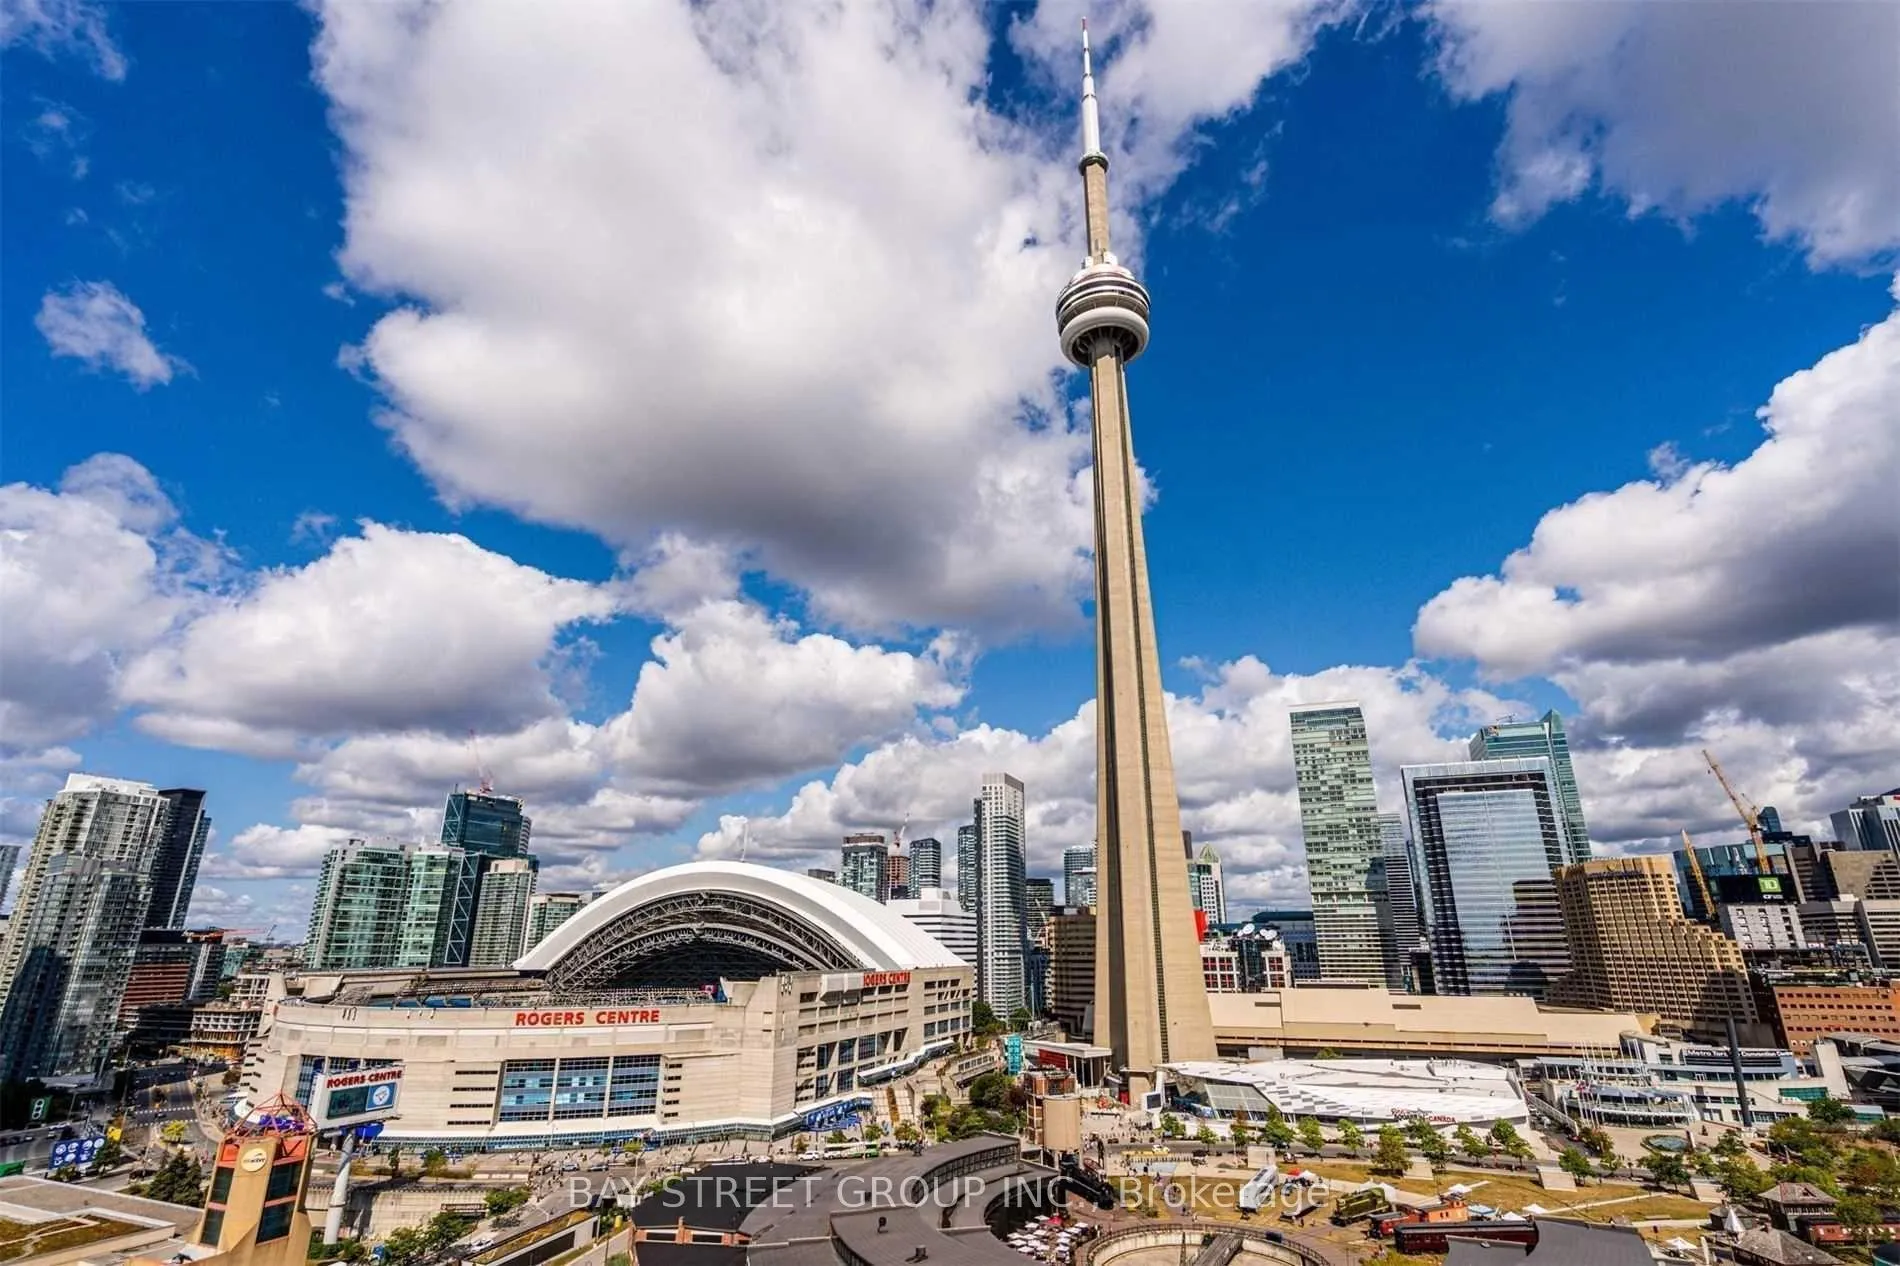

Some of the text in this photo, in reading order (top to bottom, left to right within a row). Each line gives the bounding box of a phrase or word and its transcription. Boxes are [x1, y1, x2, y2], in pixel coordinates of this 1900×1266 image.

[1760, 880, 1778, 890] TD
[515, 1010, 660, 1026] ROGERS CENTRE
[1686, 1049, 1712, 1057] Metro
[326, 1069, 403, 1089] ROGERS CENTRE
[1428, 1115, 1456, 1124] CANADA
